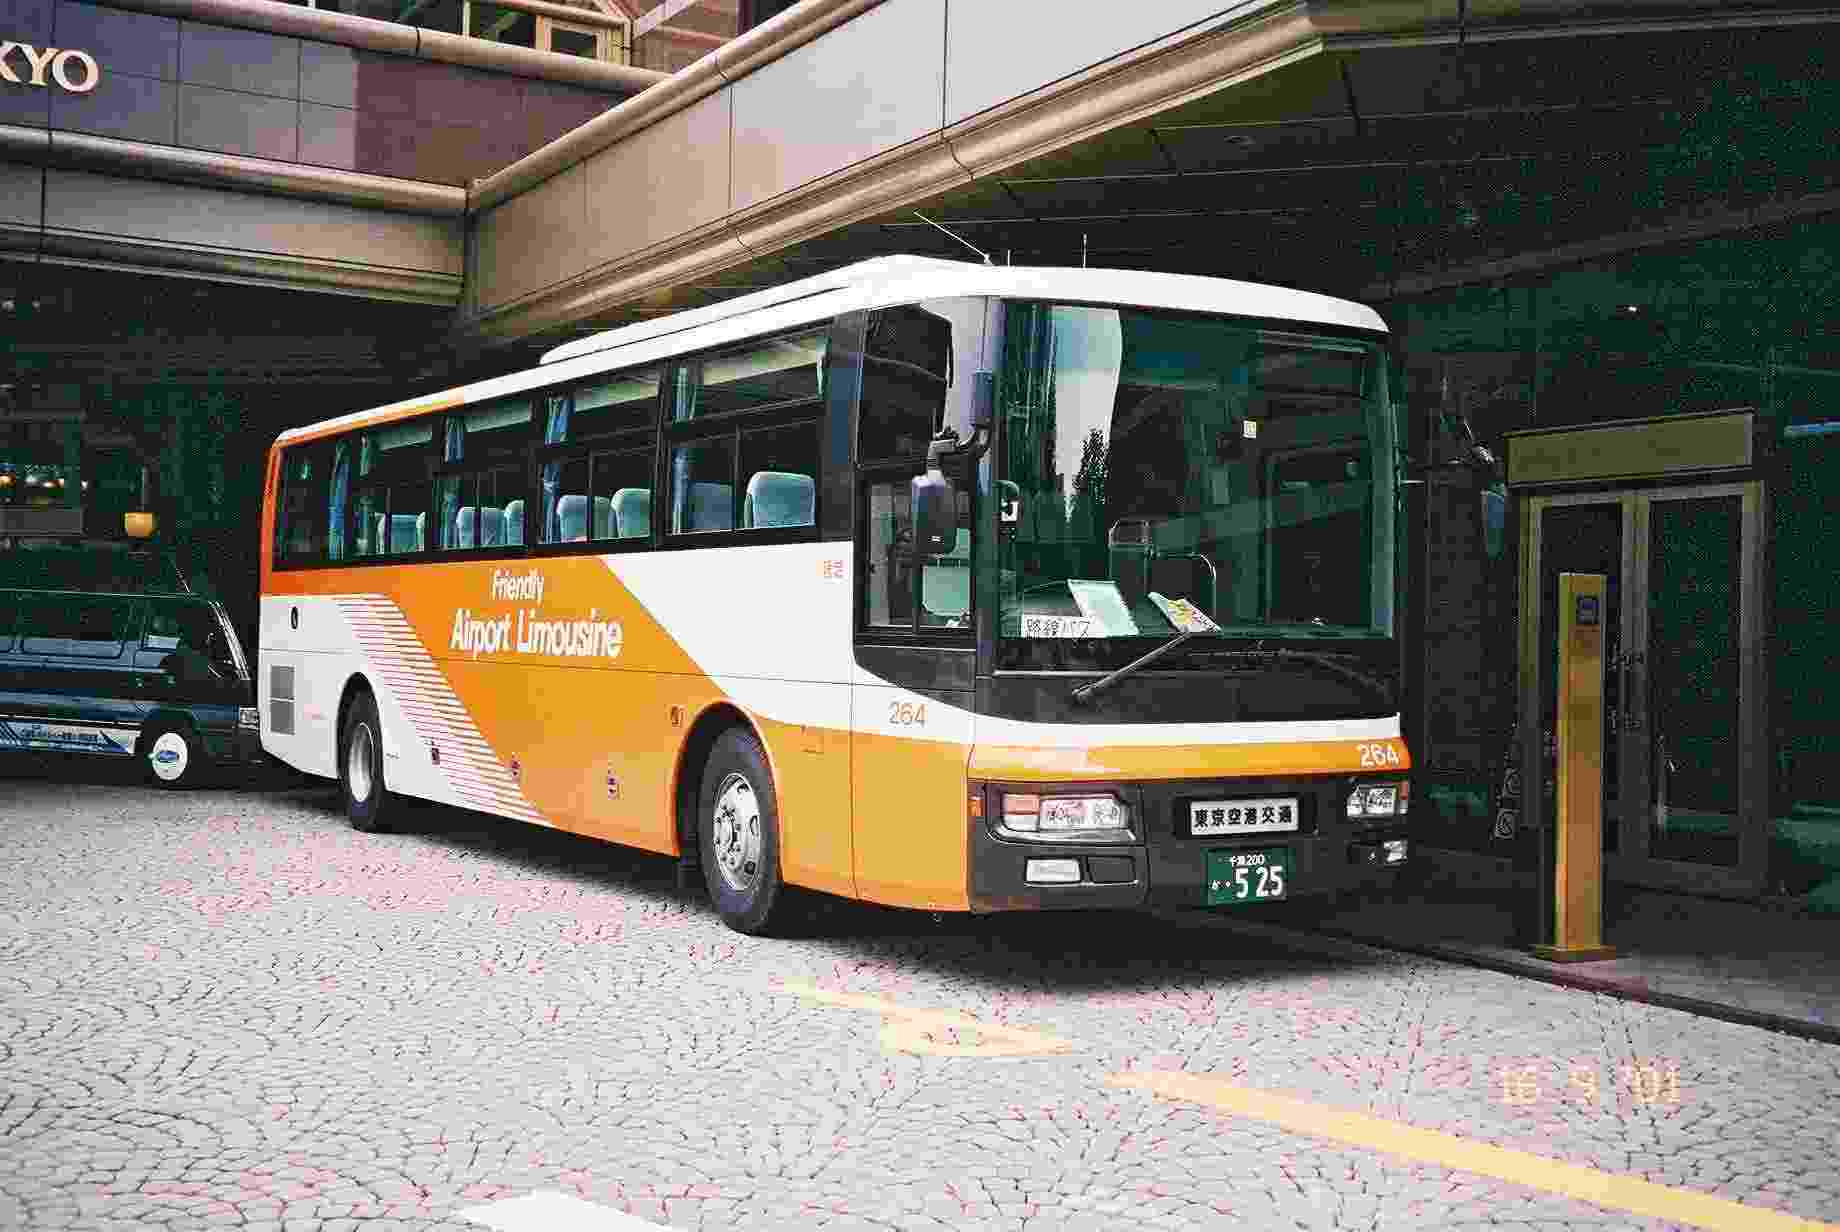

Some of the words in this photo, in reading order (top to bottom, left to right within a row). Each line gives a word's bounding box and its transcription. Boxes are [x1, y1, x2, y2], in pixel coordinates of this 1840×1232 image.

[488, 567, 545, 608] Friendly
[451, 607, 513, 662] Airport
[515, 607, 624, 658] Limousine
[888, 700, 927, 727] 264
[1356, 743, 1401, 767] 264
[1194, 805, 1293, 828] 東京空港交通
